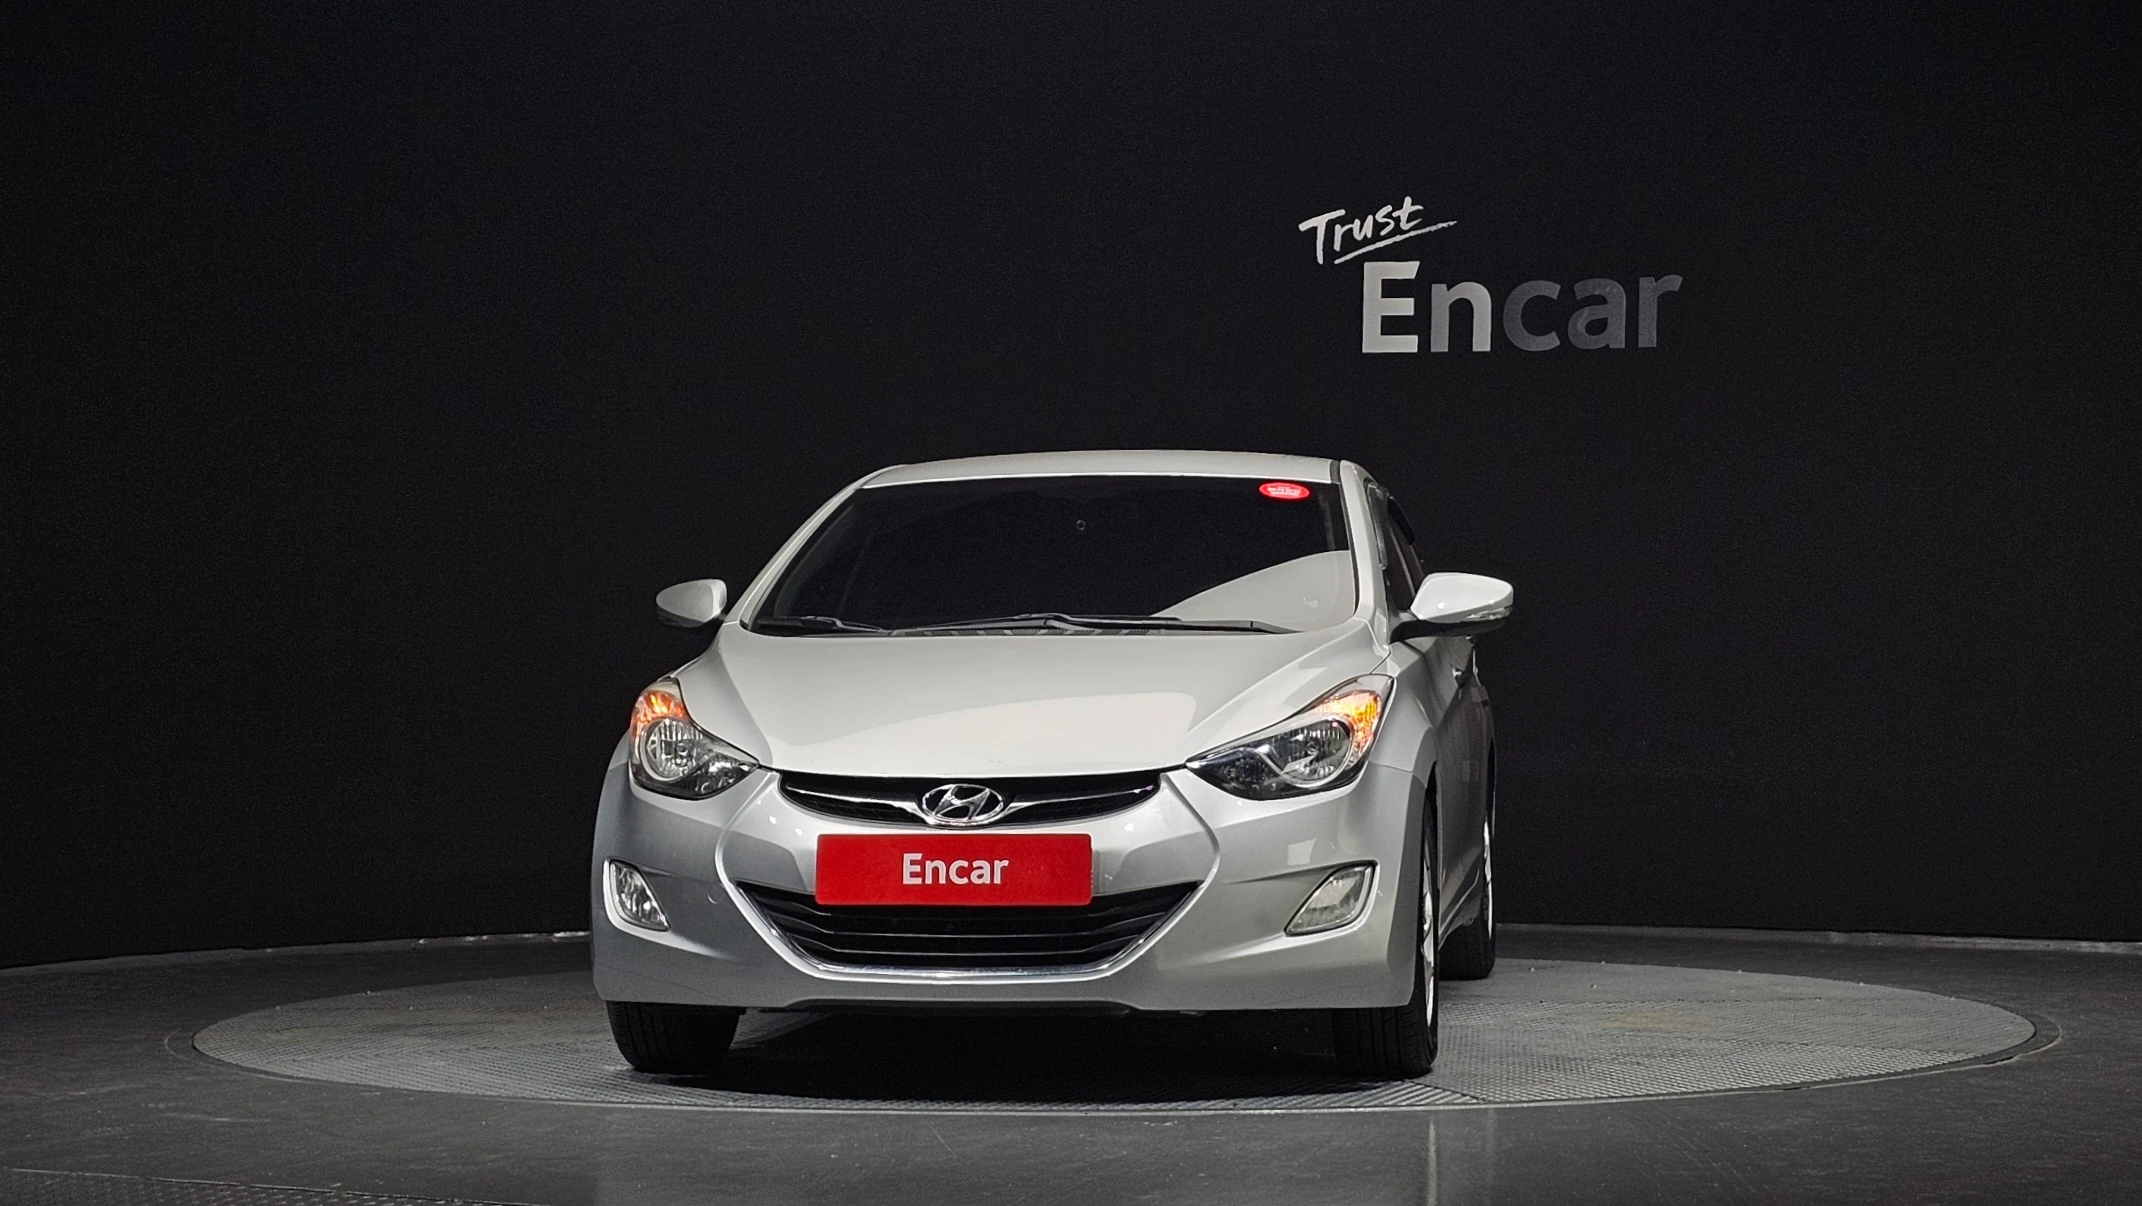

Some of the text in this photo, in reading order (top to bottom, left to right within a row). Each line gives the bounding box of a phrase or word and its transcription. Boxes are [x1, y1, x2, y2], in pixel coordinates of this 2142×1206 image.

[1298, 196, 1425, 264] Trust
[1361, 260, 1683, 353] Encar
[902, 852, 1009, 885] Encar
